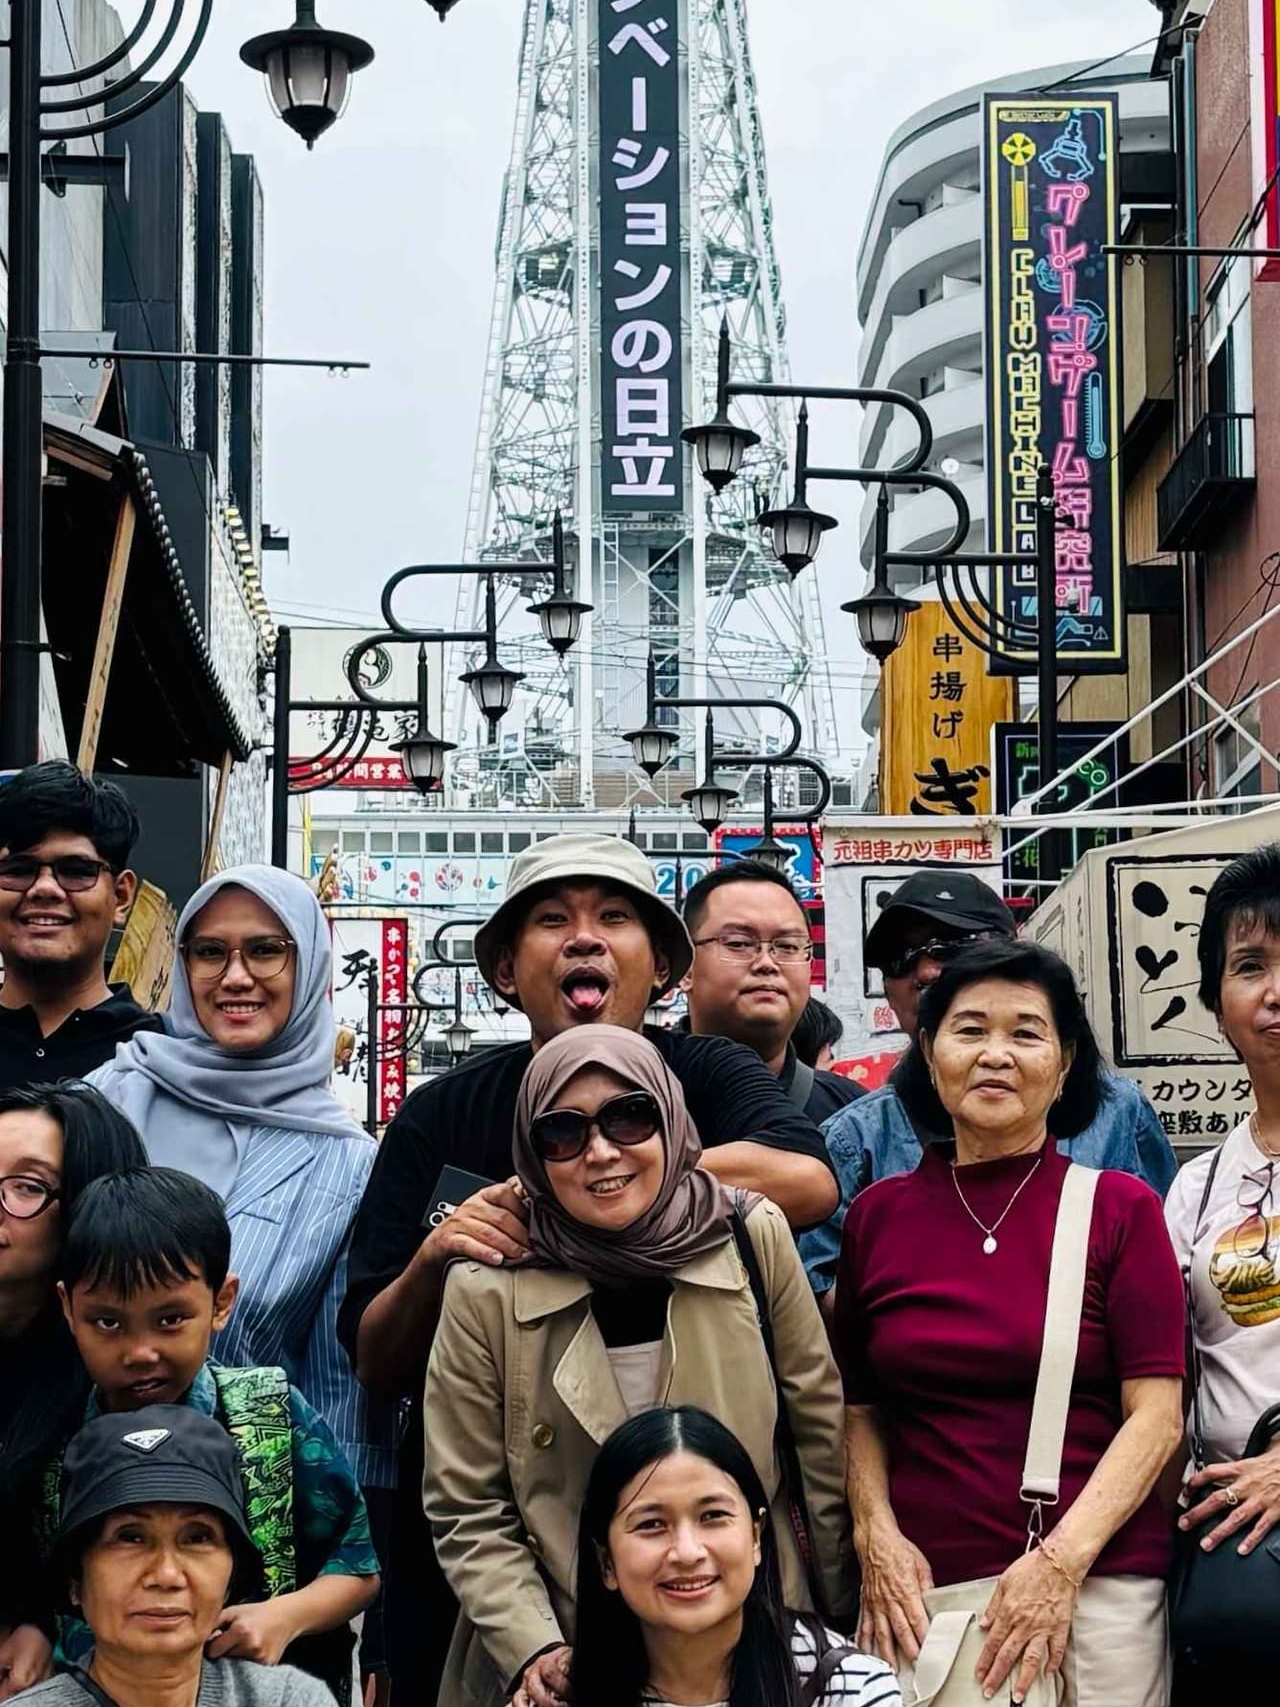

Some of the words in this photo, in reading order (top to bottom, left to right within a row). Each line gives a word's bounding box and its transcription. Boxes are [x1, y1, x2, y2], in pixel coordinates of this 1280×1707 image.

[929, 633, 968, 740] 串揚げ
[833, 838, 994, 863] 元祖串カツ専門店
